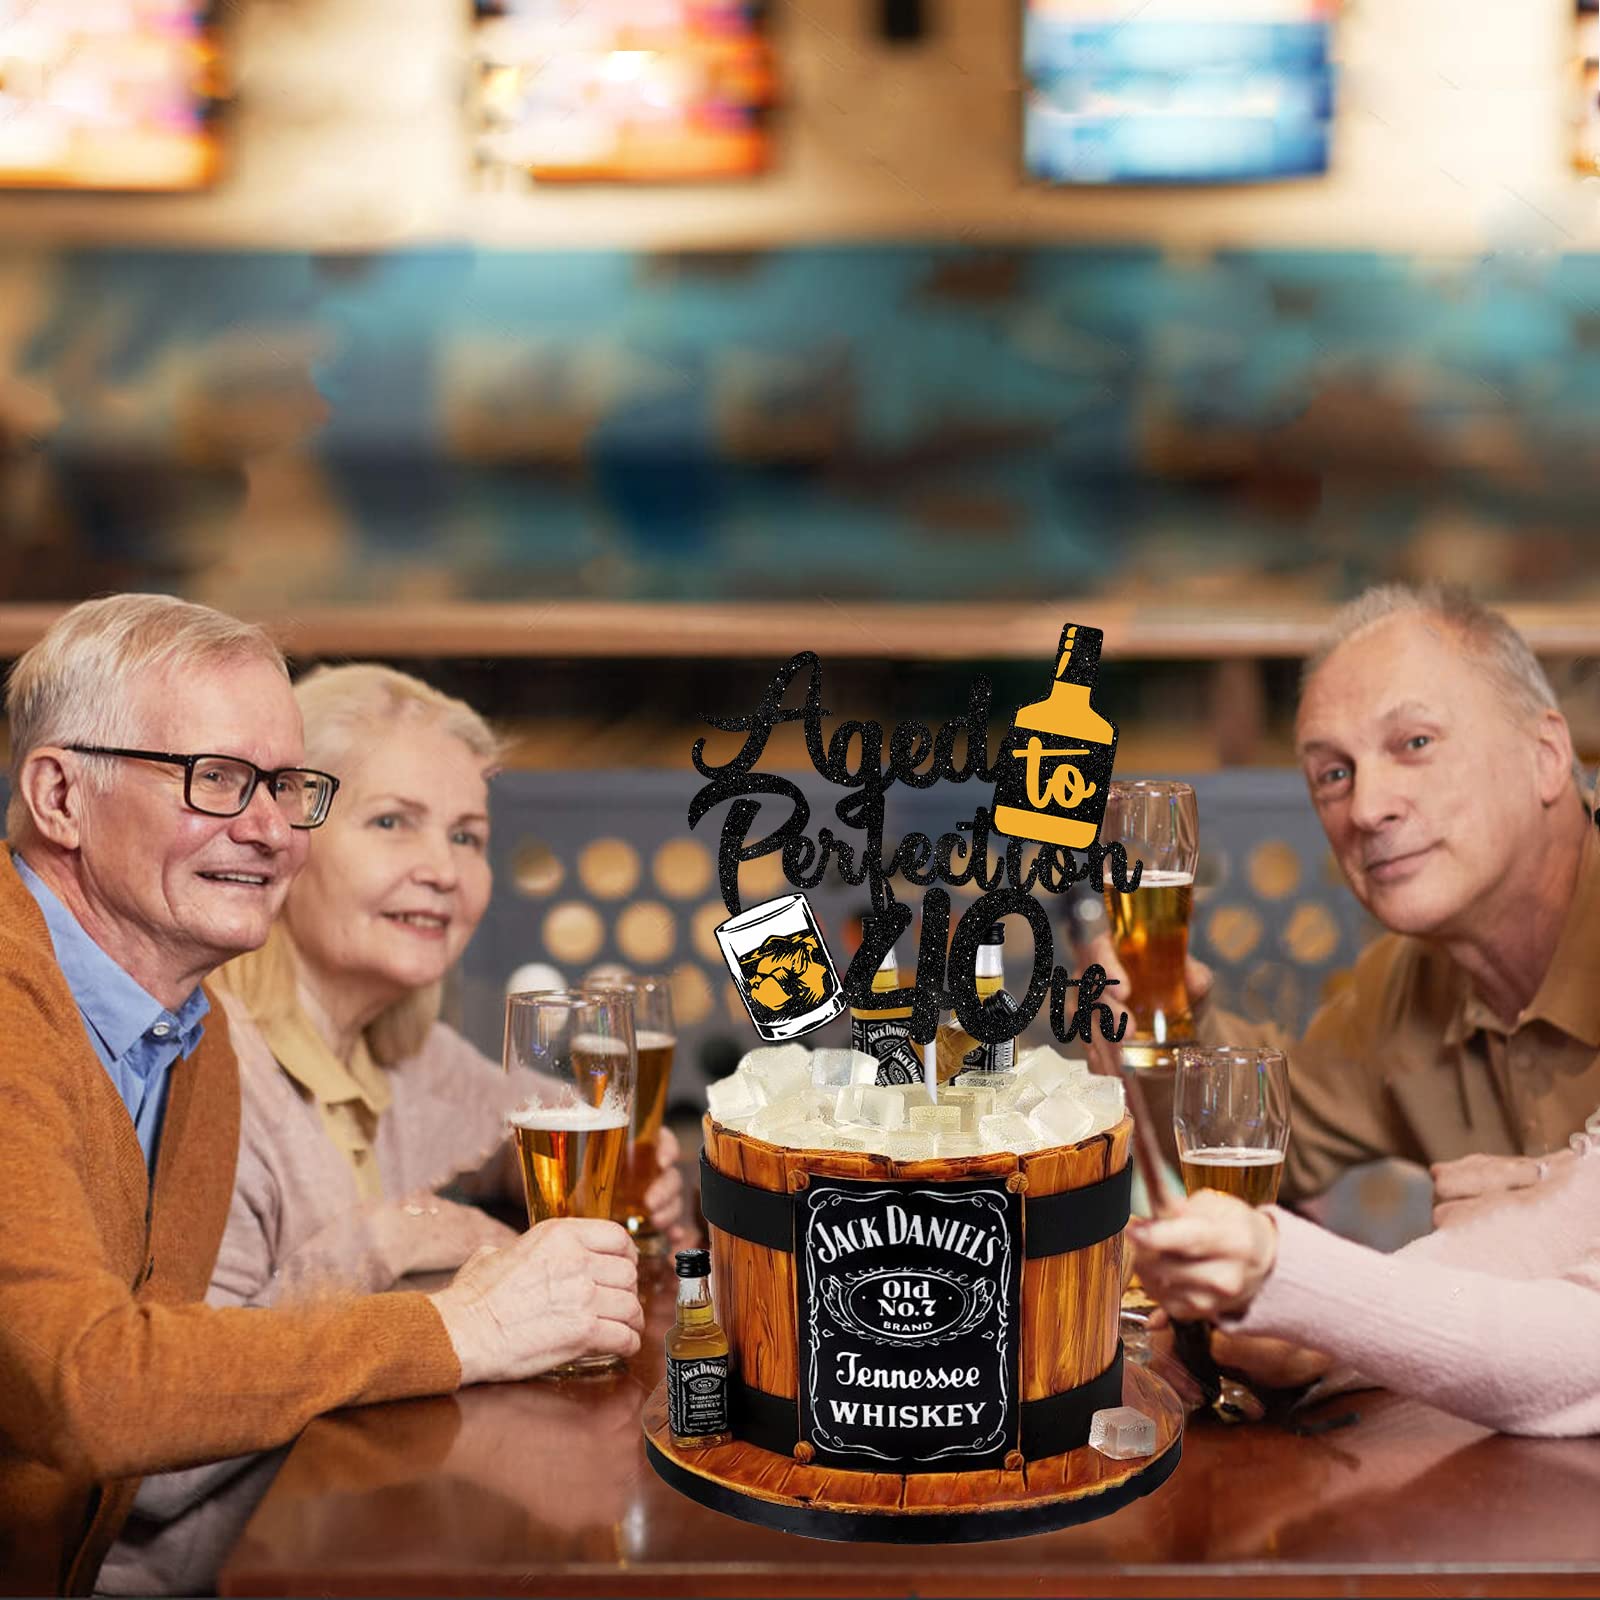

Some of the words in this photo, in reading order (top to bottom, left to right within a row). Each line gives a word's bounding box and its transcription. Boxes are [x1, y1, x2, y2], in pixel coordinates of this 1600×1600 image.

[691, 650, 1000, 829] Aged
[1013, 736, 1096, 809] to
[687, 773, 1144, 916] Perfection
[815, 1216, 884, 1264] JACK
[885, 1204, 1002, 1267] DANIEL'S
[882, 1279, 931, 1299] Old
[883, 1320, 933, 1332] BRAND
[680, 1366, 700, 1382] JACK
[835, 1351, 981, 1389] Tennessee
[828, 1399, 988, 1428] WHISKEY
